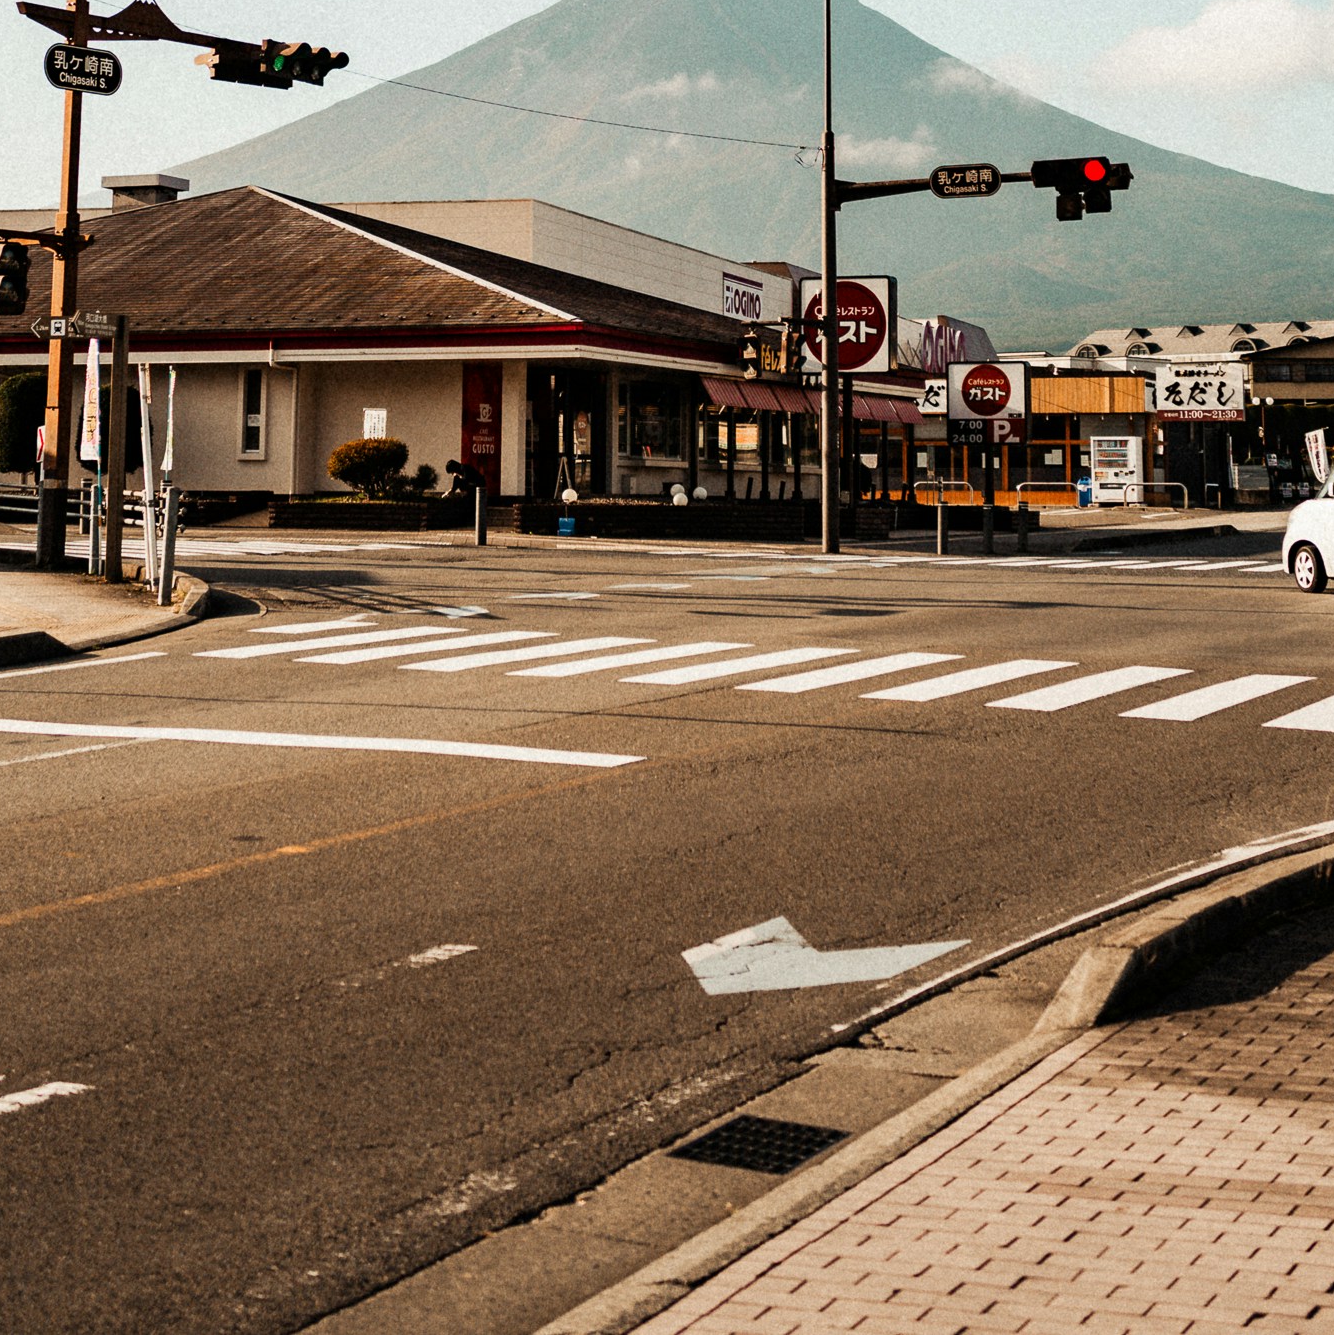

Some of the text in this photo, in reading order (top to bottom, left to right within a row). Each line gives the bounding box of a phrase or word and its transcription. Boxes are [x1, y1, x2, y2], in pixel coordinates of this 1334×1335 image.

[59, 71, 107, 89] Chigasaki S.
[944, 184, 988, 194] Chigasaki S.
[733, 287, 761, 320] OGINO
[968, 387, 1006, 401] ガスト
[958, 420, 983, 430] 7:00
[993, 419, 1011, 443] P
[952, 433, 983, 443] 24:00
[472, 443, 495, 454] GUSTO
